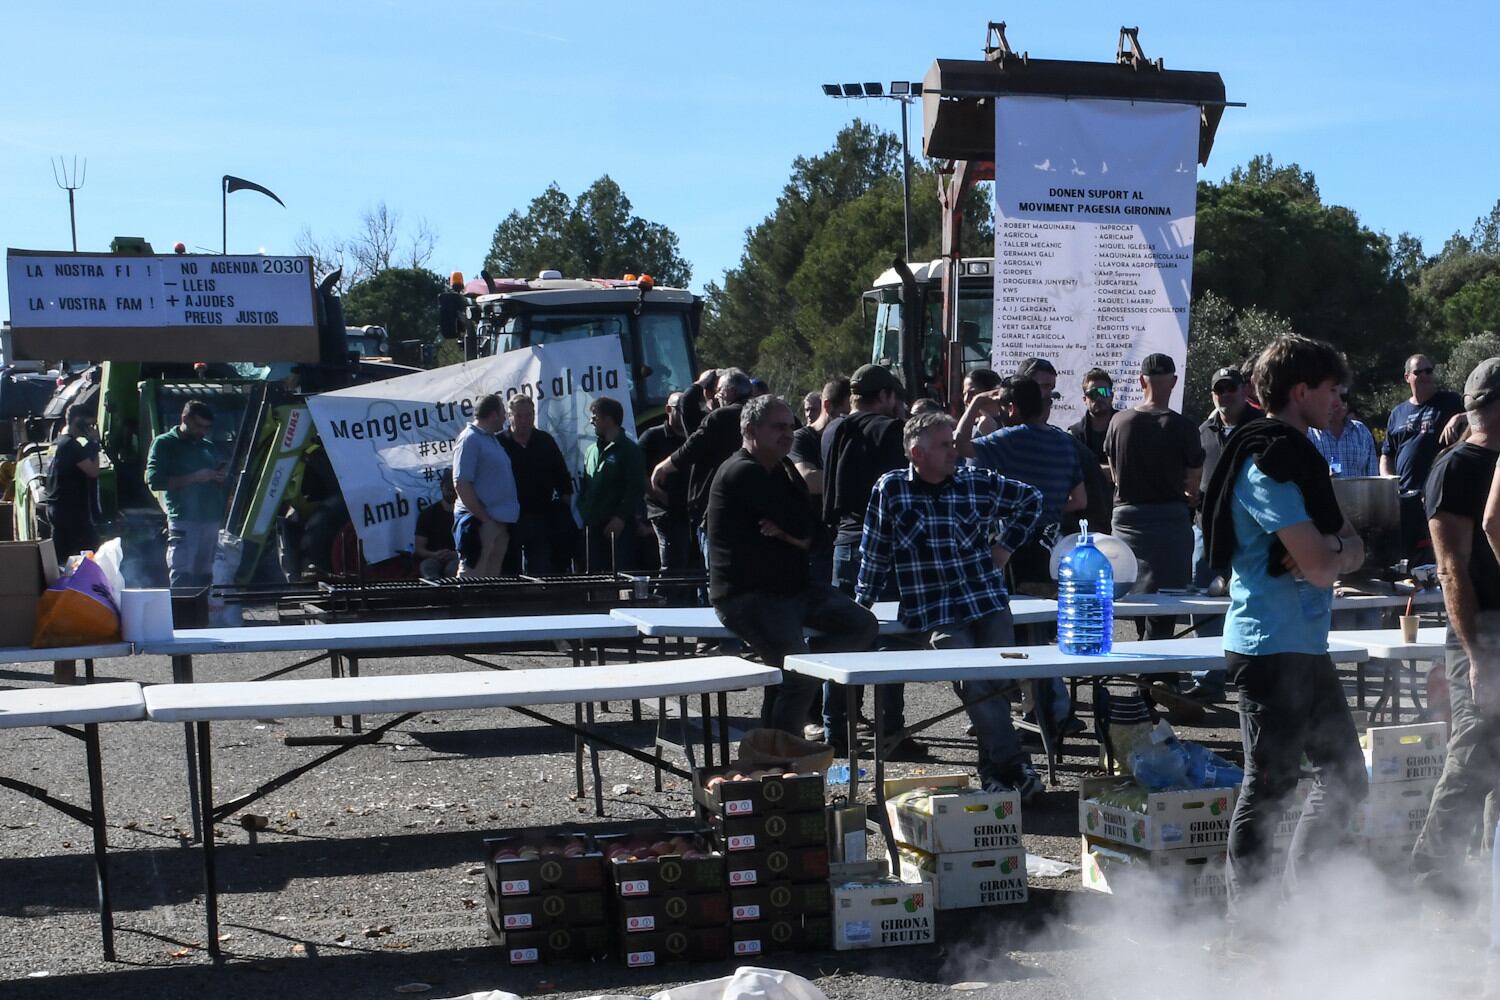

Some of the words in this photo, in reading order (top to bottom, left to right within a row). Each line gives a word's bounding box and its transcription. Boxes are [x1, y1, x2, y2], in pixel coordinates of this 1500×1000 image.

[1050, 188, 1085, 198] DONEN
[1088, 189, 1129, 199] SUPORT
[1132, 191, 1144, 200] AL
[1019, 202, 1074, 213] MOVIMENT
[1078, 204, 1121, 214] PAGESIA
[1124, 206, 1171, 216] GIRONINA
[26, 264, 43, 278] LA
[55, 263, 104, 278] NOSTRA
[181, 262, 198, 275] NO
[211, 261, 259, 274] AGENDA
[262, 259, 304, 274] 2030
[182, 279, 216, 292] LLEIS
[29, 297, 44, 311] LA
[59, 297, 107, 311] VOSTRA
[117, 297, 143, 311] FAM
[185, 296, 235, 308] AJUDES
[185, 311, 223, 324] PREUS
[236, 311, 279, 325] JUSTOS
[330, 406, 429, 442] Mengeu
[552, 368, 573, 397] al
[581, 365, 619, 392] dia
[364, 494, 410, 528] Amb
[1103, 810, 1127, 826] GIRONA
[974, 824, 1017, 836] GIRONA
[1104, 823, 1127, 840] FRUITS
[1190, 819, 1230, 832] GIRONA
[974, 835, 1018, 847] FRUITS
[980, 878, 1023, 891] GIRONA
[980, 889, 1024, 903] FRUITS
[881, 917, 929, 930] GIRONA
[881, 929, 930, 943] FRUITS
